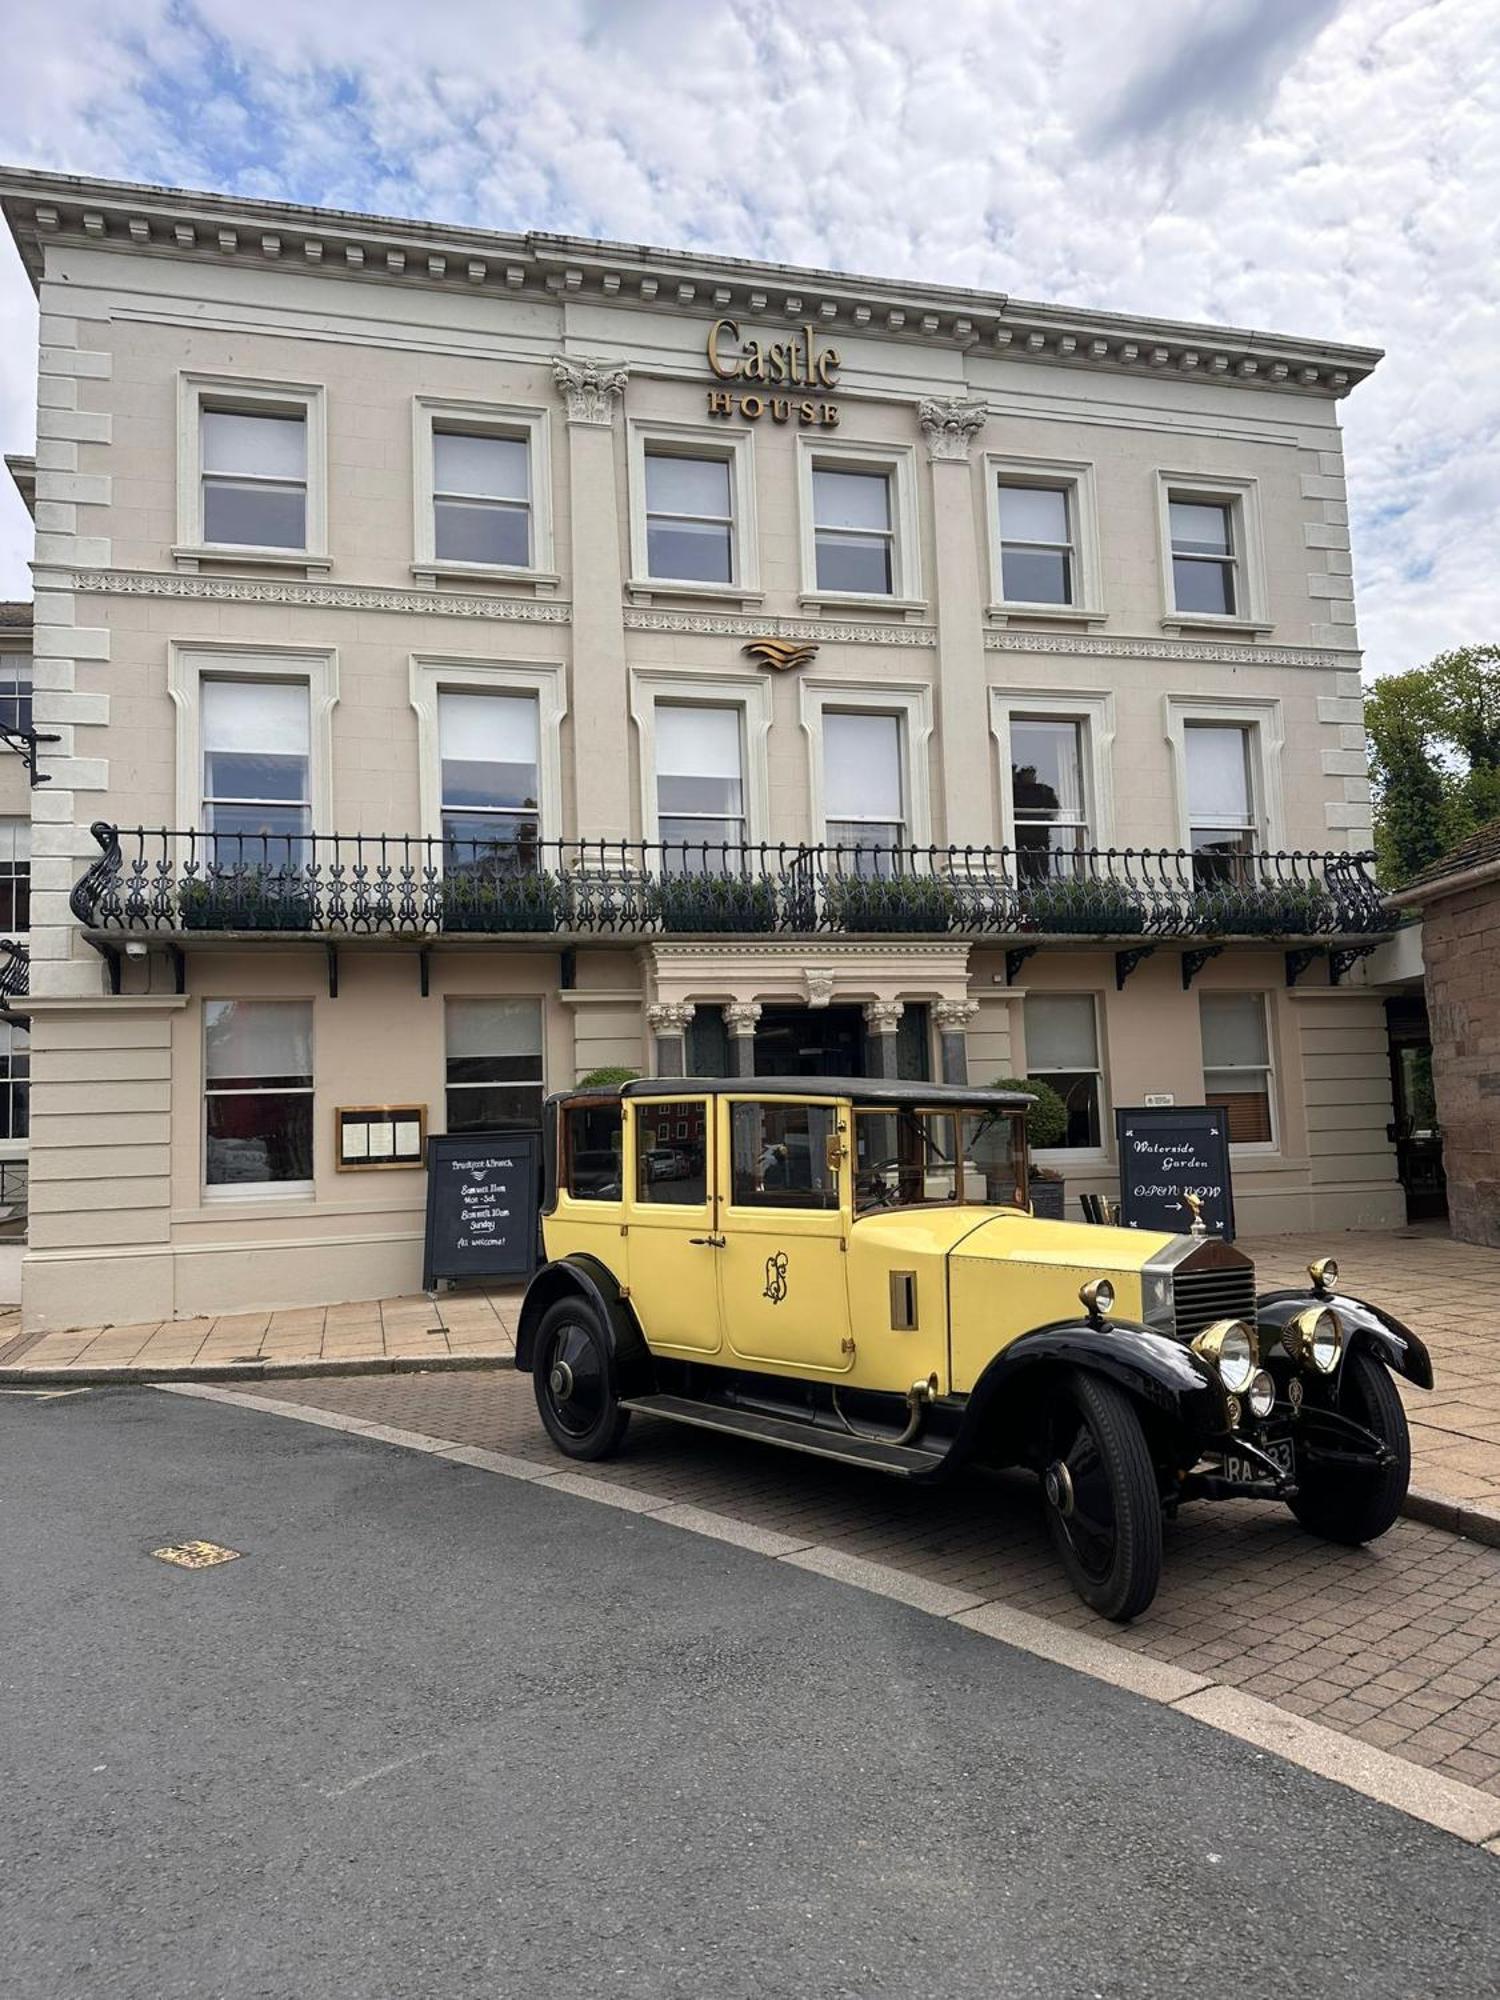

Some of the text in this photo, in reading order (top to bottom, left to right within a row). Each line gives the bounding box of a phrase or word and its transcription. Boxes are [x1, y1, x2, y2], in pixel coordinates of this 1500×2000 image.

[708, 319, 841, 389] Castle
[708, 391, 840, 427] HOUSE
[1134, 1141, 1194, 1153] Waterside
[1162, 1156, 1208, 1172] Garden
[1134, 1184, 1179, 1197] OPEN
[470, 1220, 496, 1232] Sunday
